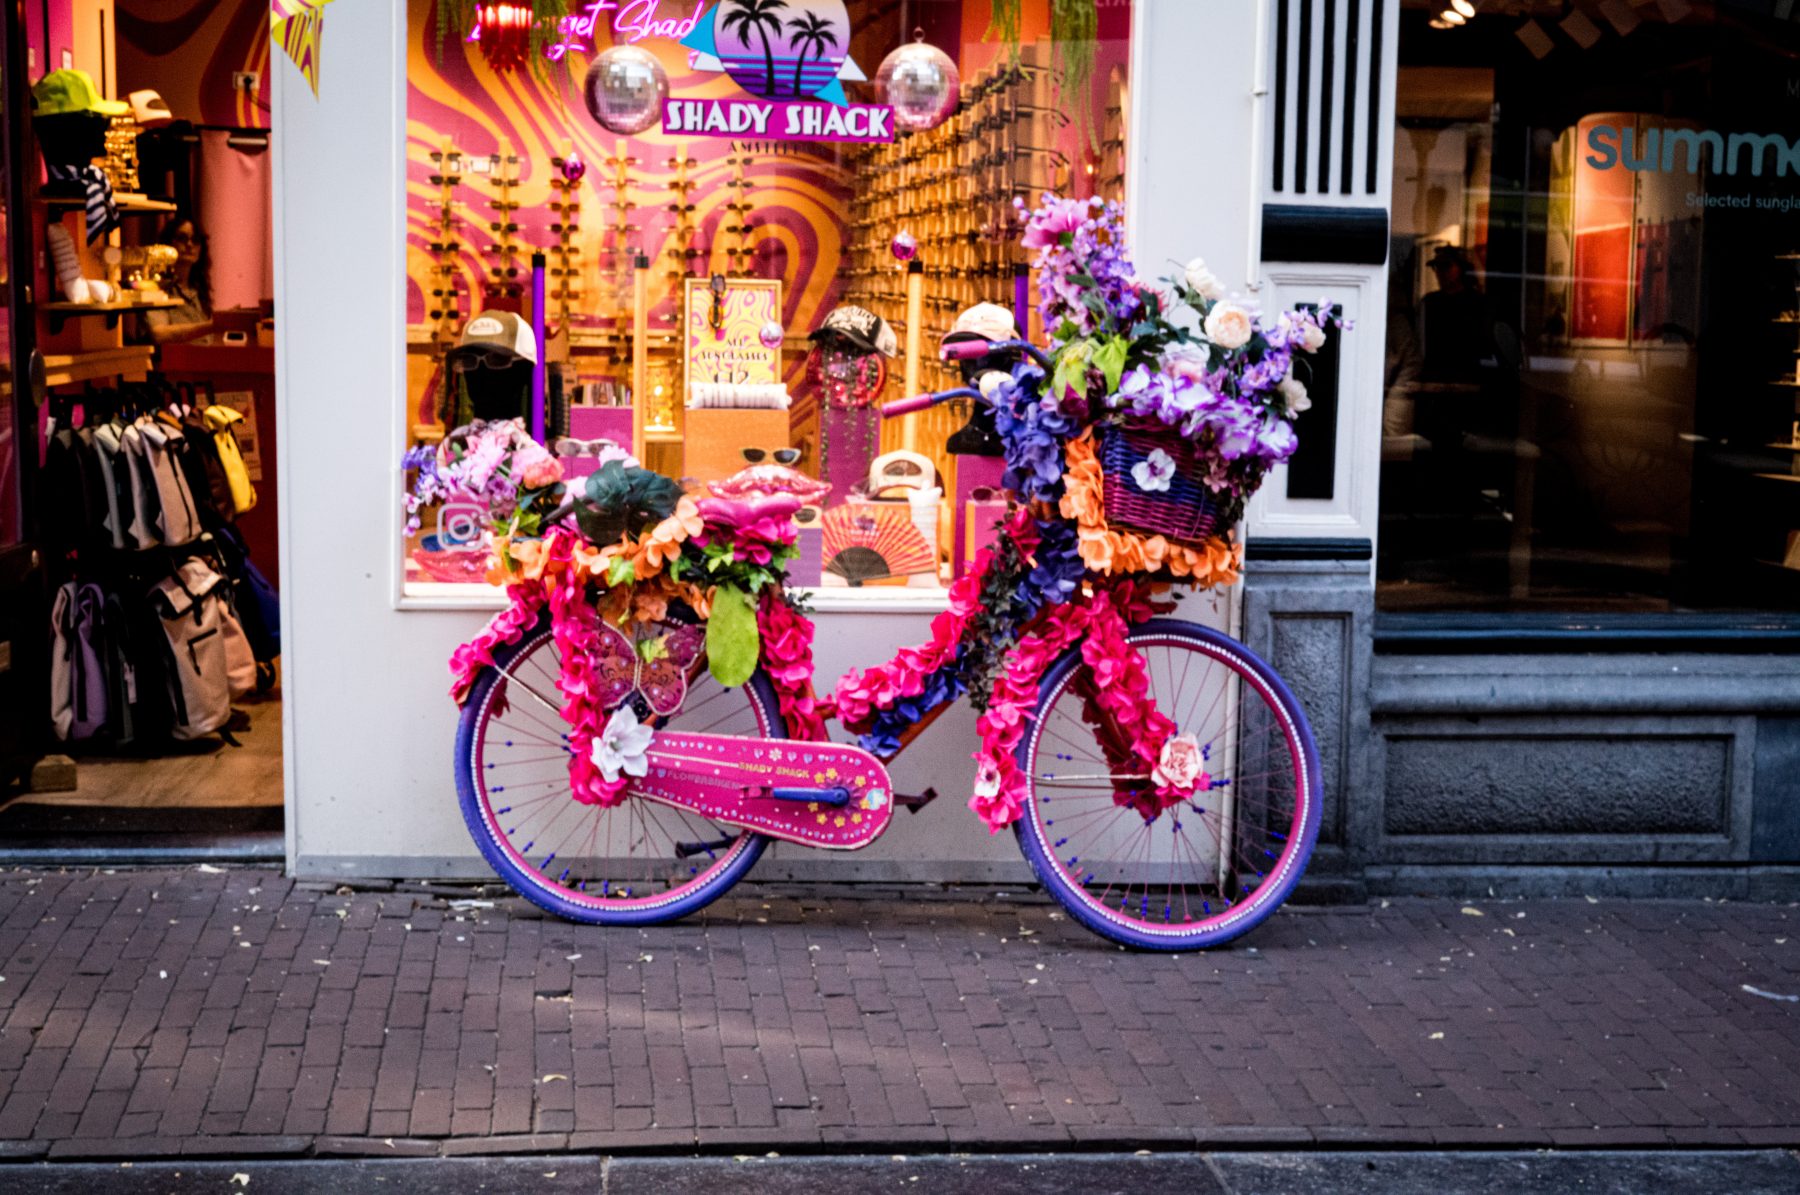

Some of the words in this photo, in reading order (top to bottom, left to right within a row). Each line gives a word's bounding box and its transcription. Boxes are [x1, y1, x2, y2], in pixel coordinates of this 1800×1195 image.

[613, 0, 703, 43] Shad
[666, 100, 772, 134] SHADY
[784, 105, 890, 138] SHACK
[1686, 192, 1751, 208] Selected
[701, 351, 767, 361] SUNGLASSES
[738, 762, 773, 774] SHADY
[776, 766, 810, 779] SHACK
